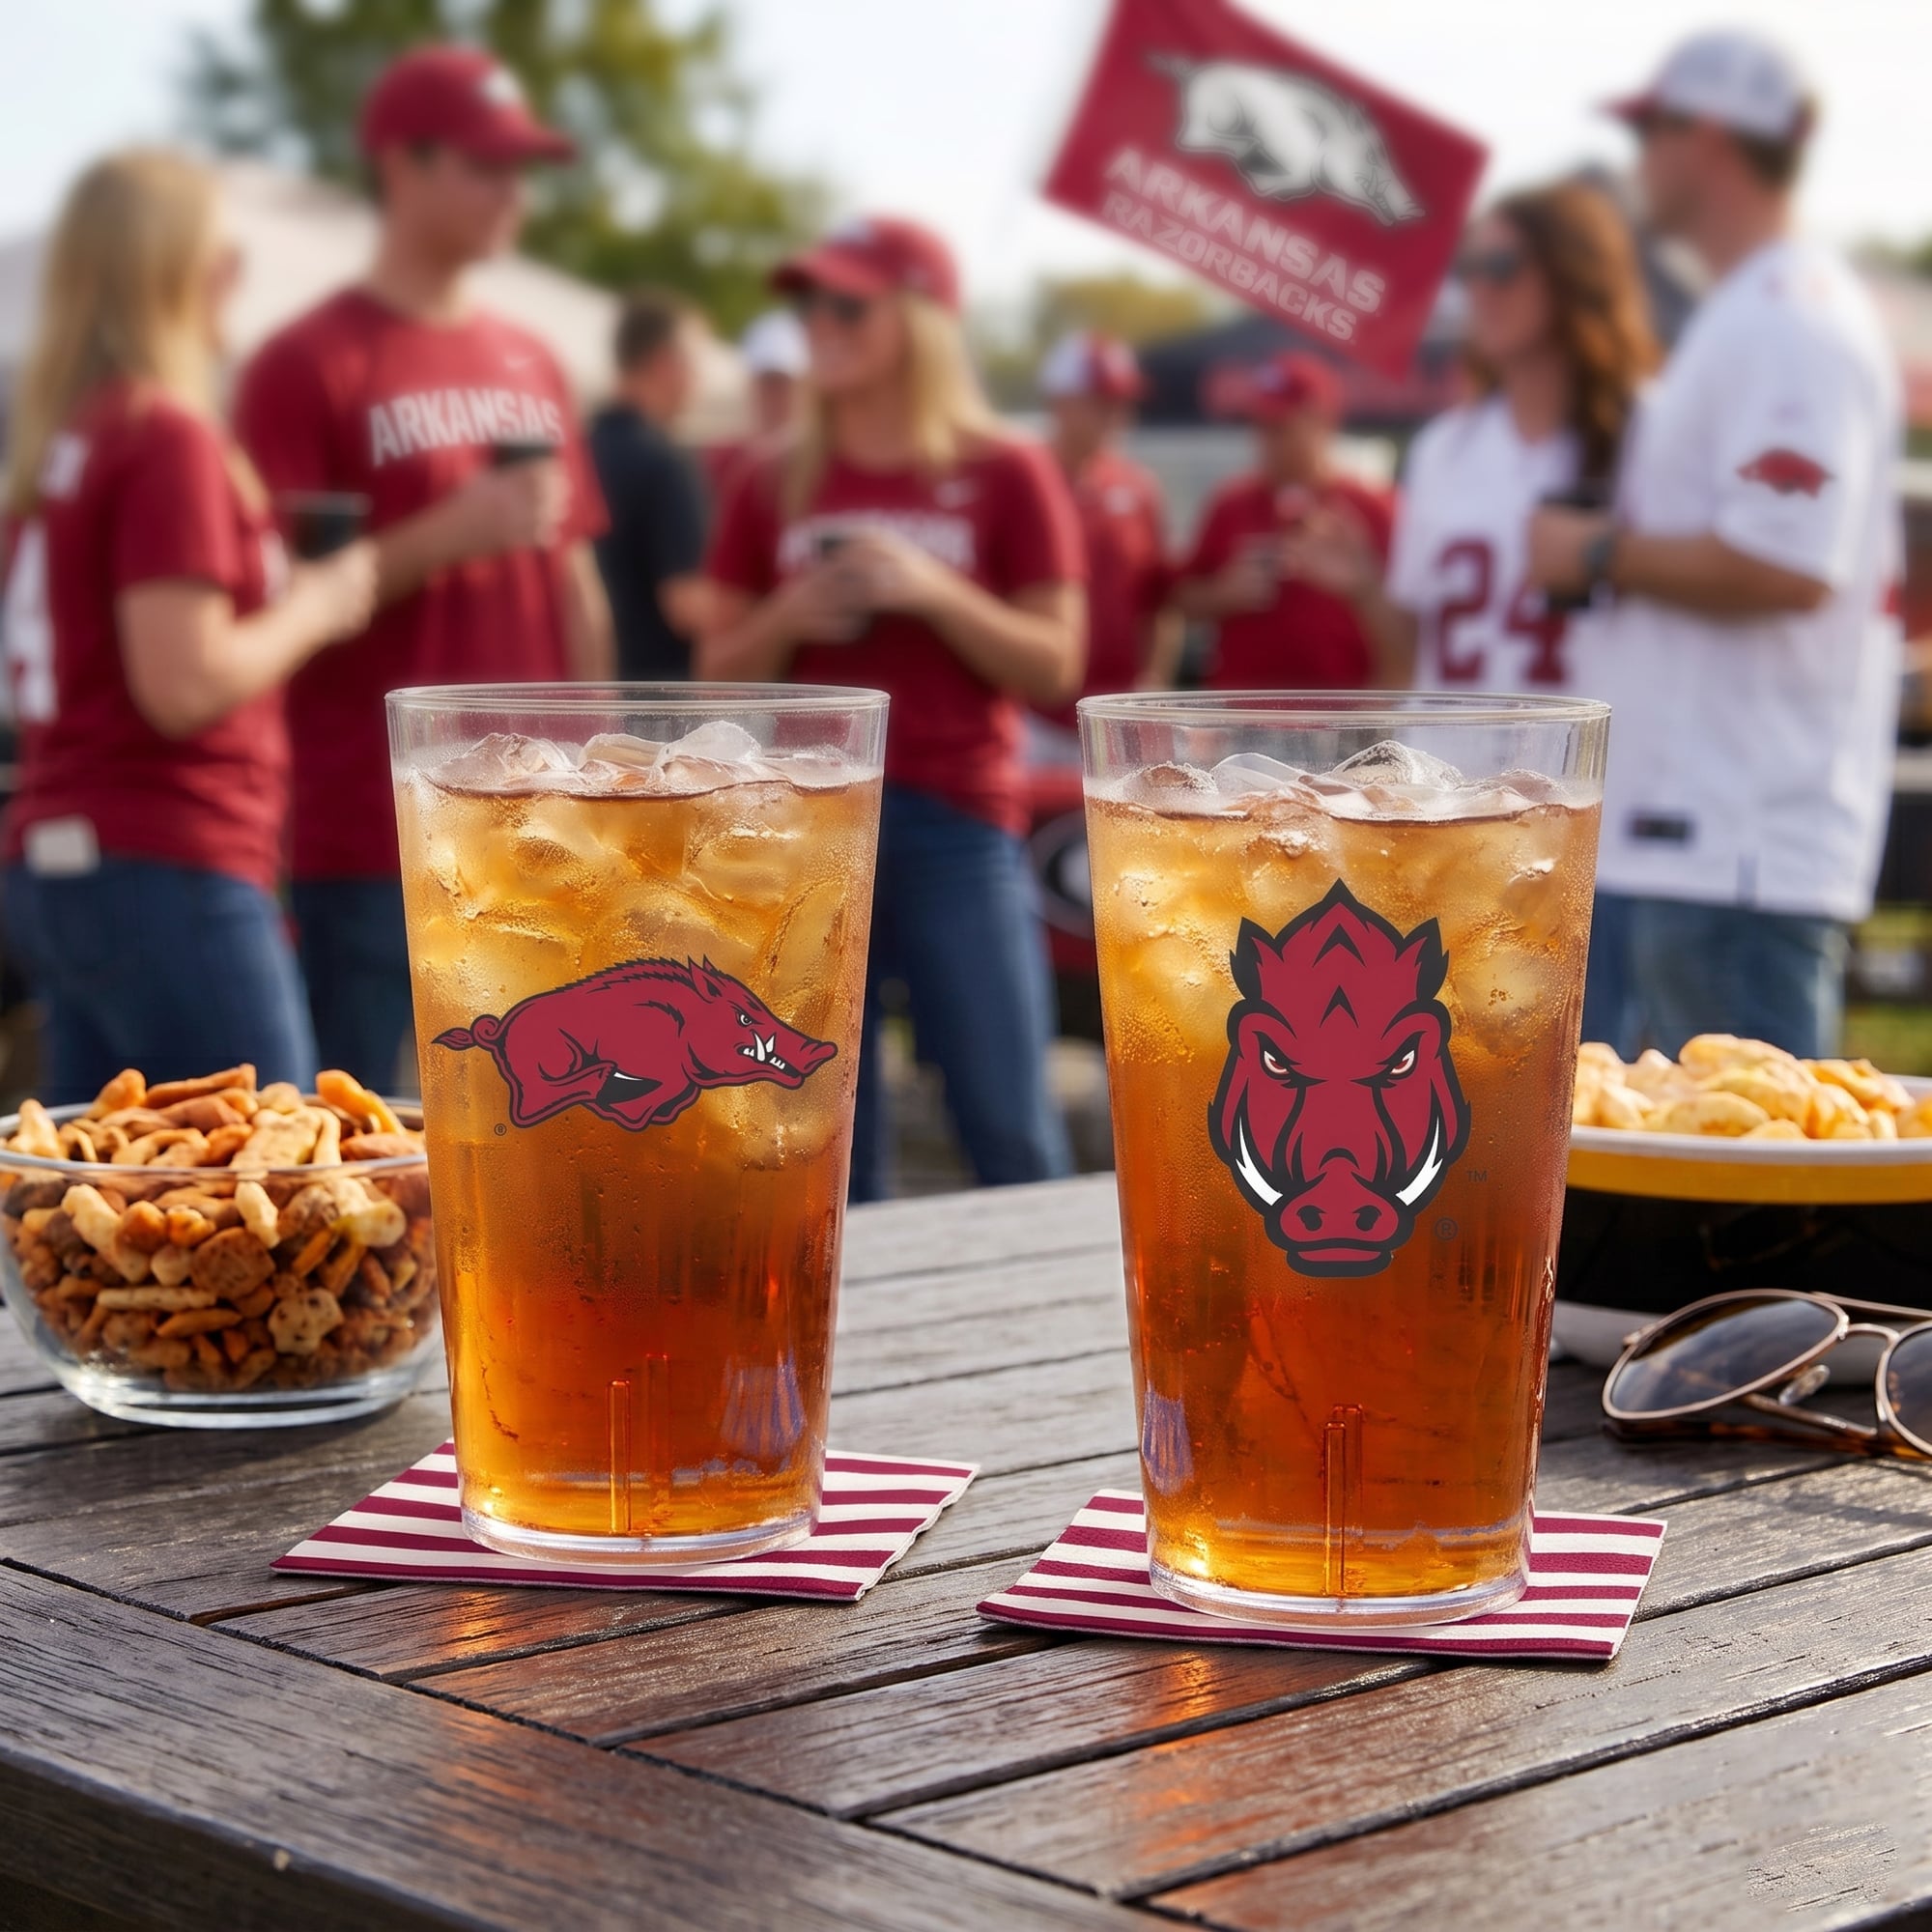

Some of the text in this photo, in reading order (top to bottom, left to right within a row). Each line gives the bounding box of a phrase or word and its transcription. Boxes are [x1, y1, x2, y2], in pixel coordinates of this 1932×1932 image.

[1100, 190, 1357, 341] RAZORBACKS
[1103, 147, 1386, 313] ARKANSAS
[369, 387, 565, 468] ARKANSAS
[1436, 539, 1570, 684] 24
